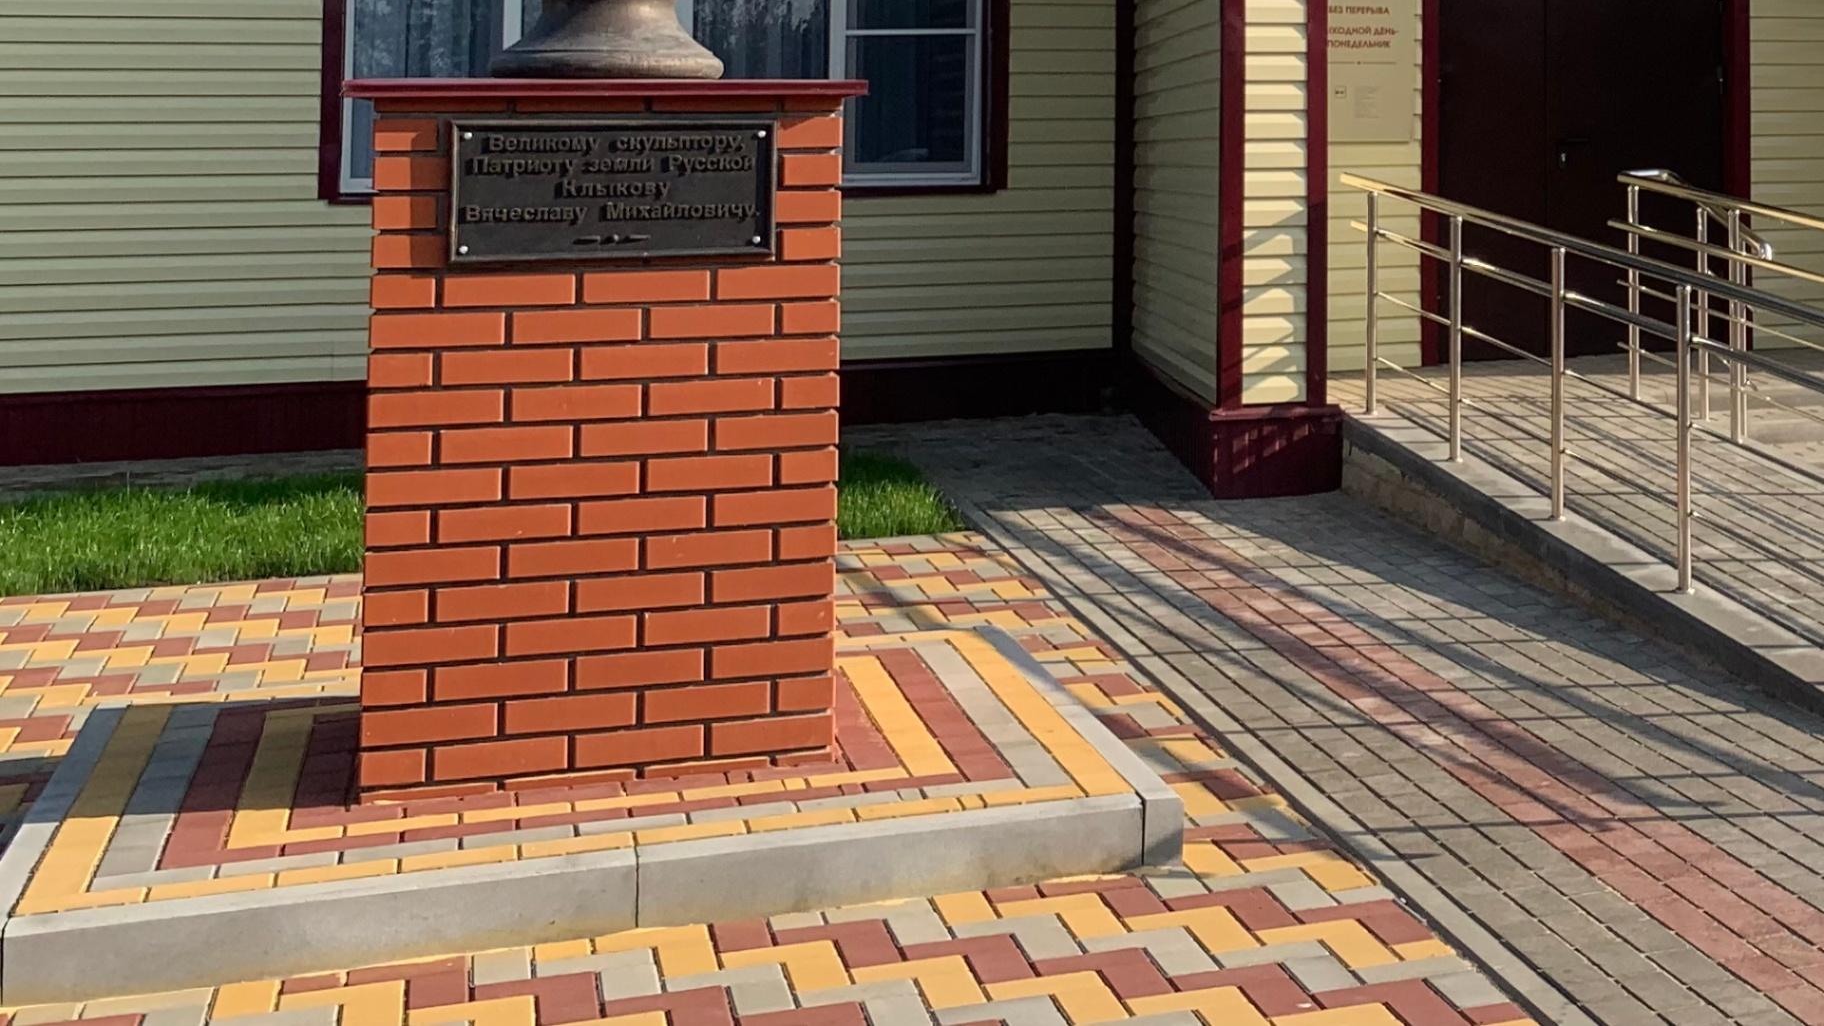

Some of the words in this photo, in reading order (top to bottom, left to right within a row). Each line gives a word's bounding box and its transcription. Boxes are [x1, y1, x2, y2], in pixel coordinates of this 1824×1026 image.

[1345, 5, 1390, 15] ПЕРЕРЫВА
[487, 133, 599, 155] Великому
[616, 133, 746, 154] скульптору,
[471, 155, 575, 177] Патриоту
[587, 156, 655, 173] земли
[561, 178, 671, 198] Клыкову
[465, 204, 588, 225] Вячеславу
